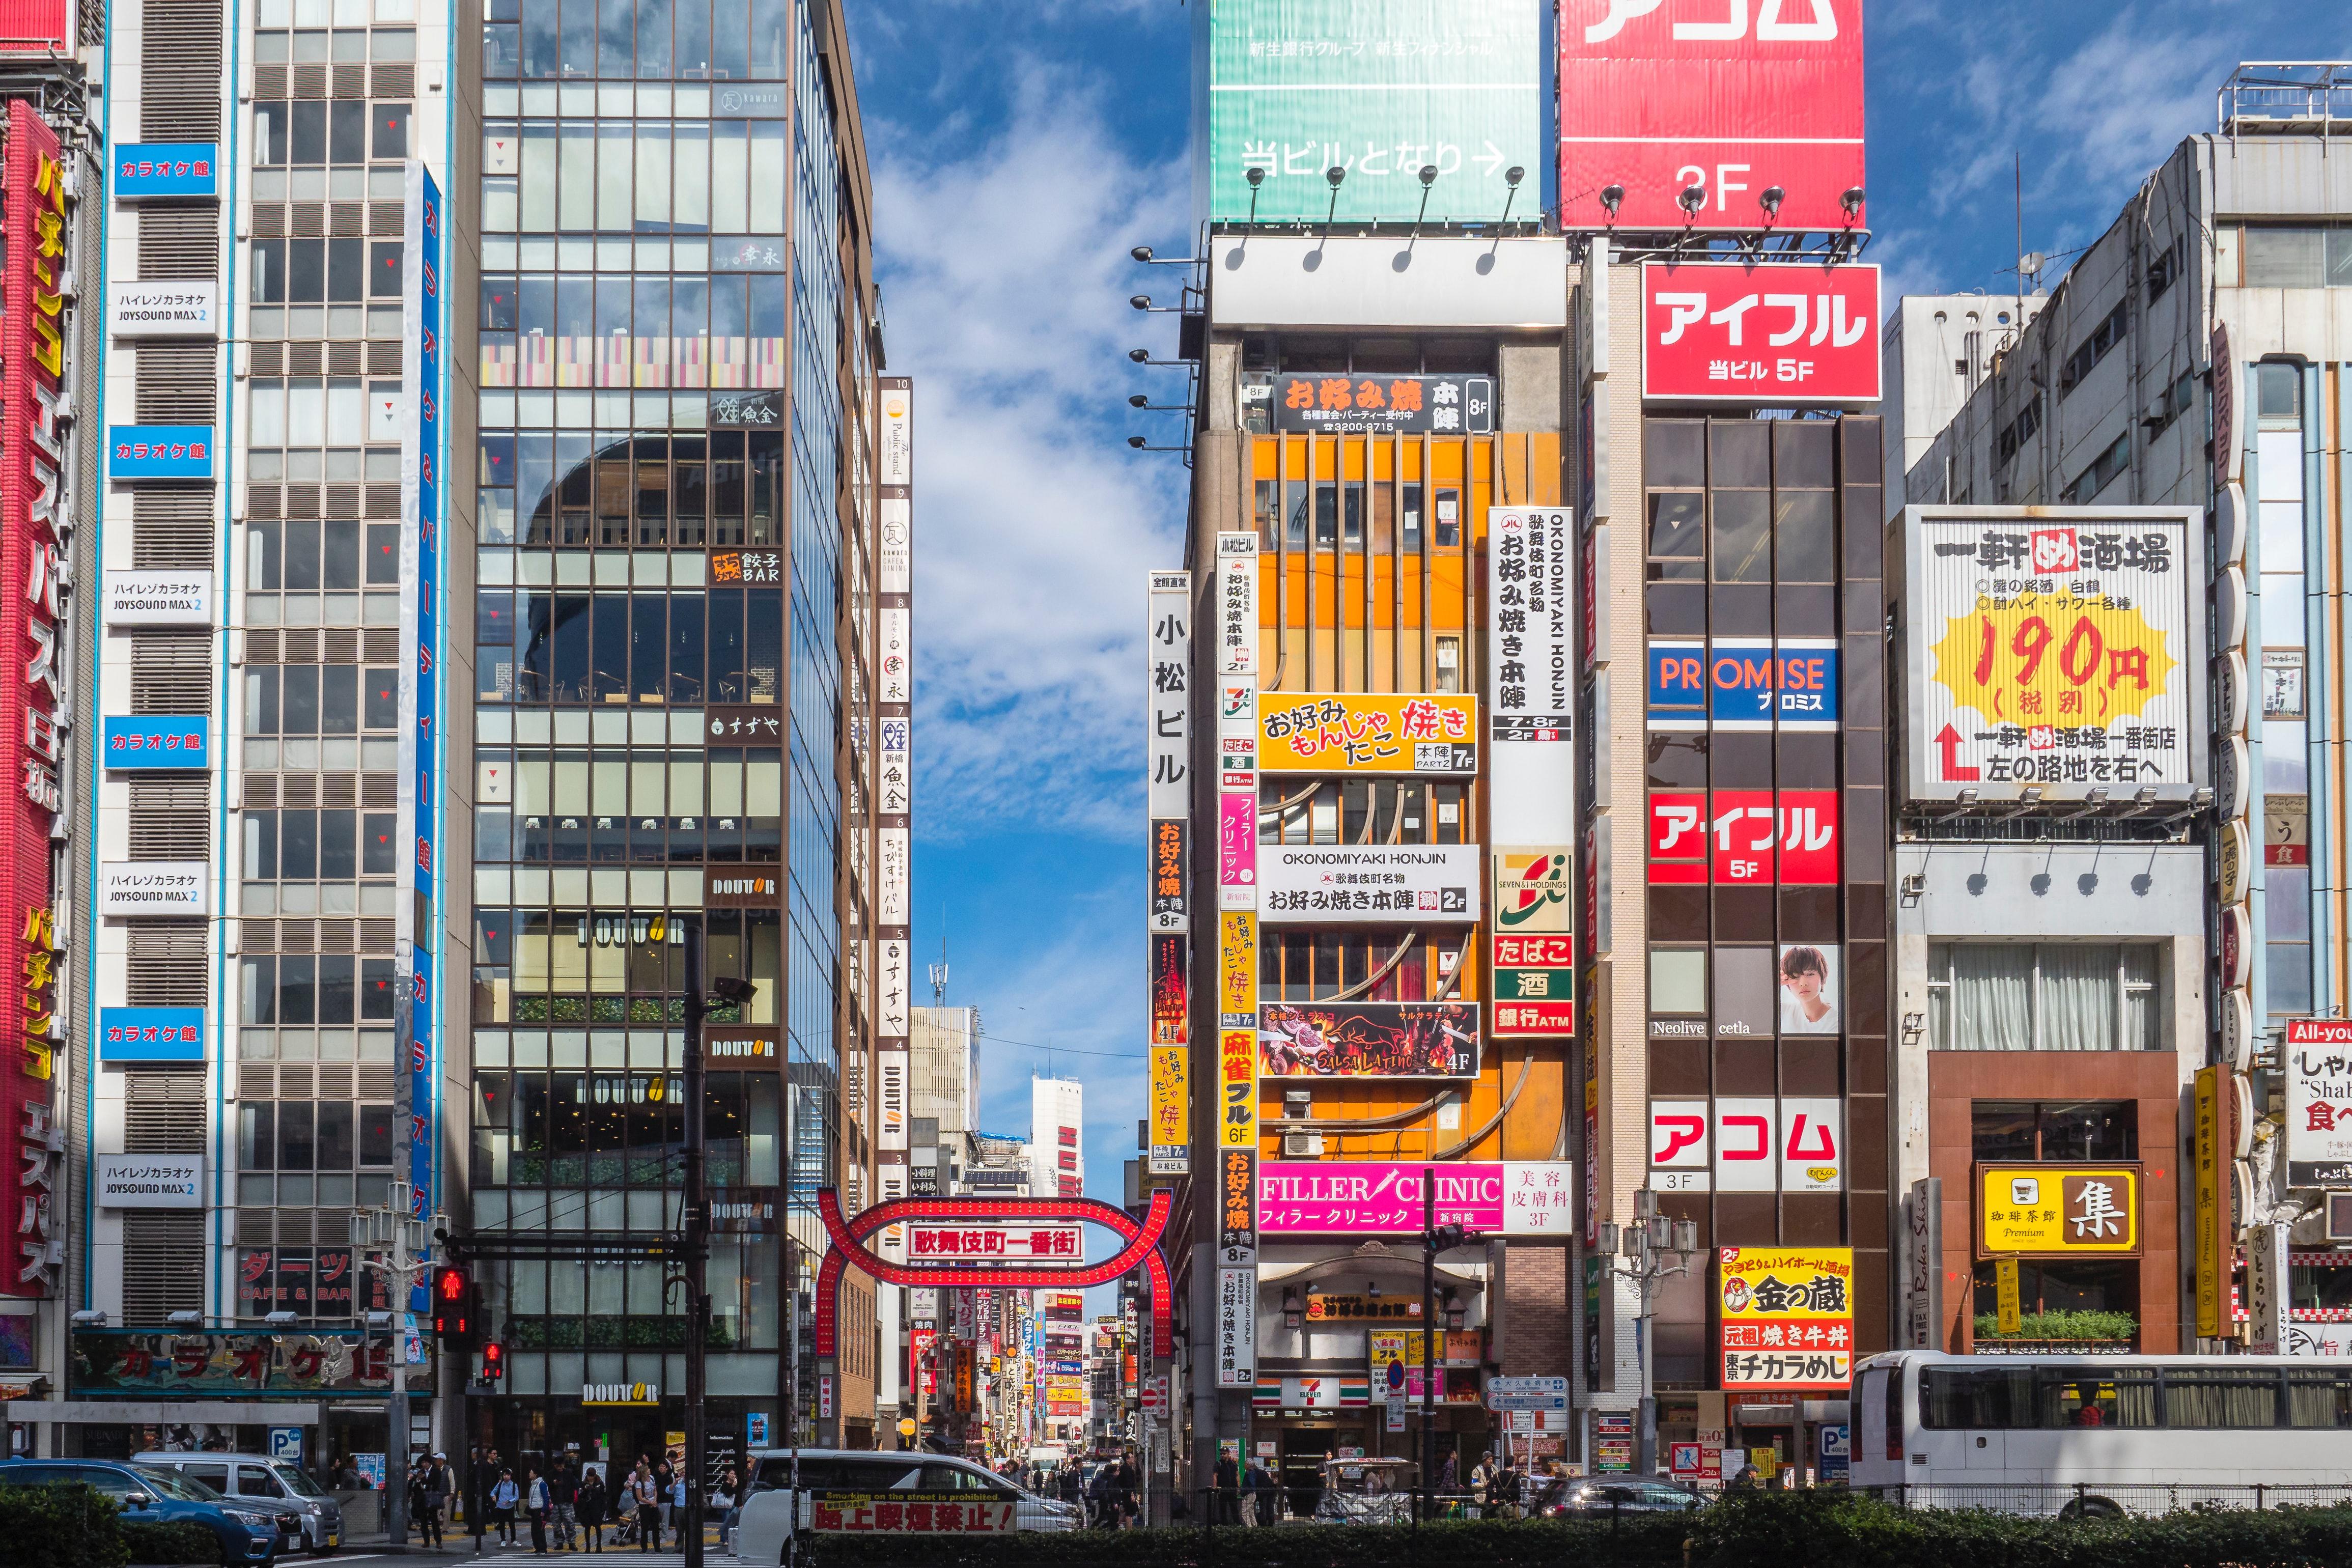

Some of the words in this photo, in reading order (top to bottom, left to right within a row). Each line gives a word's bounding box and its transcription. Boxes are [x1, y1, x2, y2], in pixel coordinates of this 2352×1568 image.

[1242, 140, 1462, 177] 当ビルとなり
[121, 160, 210, 178] カラオケ館
[1675, 164, 1750, 211] 3F
[120, 294, 206, 306] ハイレゾカラオケ
[119, 310, 171, 321] JOYSOUND
[199, 310, 207, 321] 2
[1655, 292, 1867, 347] アイフル
[1709, 360, 1768, 381] 当ビル
[1777, 359, 1814, 382] 5F
[897, 379, 908, 389] 10
[1250, 387, 1264, 397] 8F
[1285, 379, 1423, 411] お好み焼
[1433, 381, 1460, 430] 本陣
[1469, 399, 1488, 415] 8F
[741, 406, 778, 424] 魚金
[893, 423, 902, 449] Public
[1334, 423, 1393, 432] 3200-9715
[117, 443, 206, 460] カラオケ館
[893, 451, 902, 475] stand
[898, 488, 904, 498] 9
[1222, 538, 1253, 553] 小松ビル
[1934, 527, 2172, 575] 一軒め酒場
[742, 553, 780, 568] 餃子
[1528, 514, 1545, 612] 歌舞伎町名物
[743, 568, 779, 581] BAR
[1550, 514, 1564, 638] OKONOMIYAKI
[115, 583, 201, 595] ハイレゾカラオケ
[2070, 579, 2100, 594] 白鶴
[114, 599, 166, 610] JOYSOUND
[194, 599, 202, 610] 2
[898, 598, 904, 608] 8
[1498, 534, 1526, 709] お好み焼き本陣
[1973, 615, 2149, 690] 190円
[1227, 662, 1248, 671] 2F
[1660, 658, 1825, 689] PROMISE
[1551, 645, 1565, 710] HONJIN
[1154, 614, 1186, 785] 小松ビル
[1757, 691, 1824, 711] プロミス
[898, 707, 904, 716] 7
[1401, 699, 1467, 738] 焼き
[729, 716, 779, 736] すずや
[1507, 730, 1533, 740] 2F
[112, 734, 201, 751] カラオケ館
[1223, 739, 1253, 752] たばこ
[1974, 723, 2176, 751] 一軒め酒場一番街店
[1417, 745, 1450, 759] 本陣
[1453, 749, 1474, 768] 7F
[1231, 757, 1245, 769] 酒
[1986, 754, 2163, 782] 左の路地を右へ
[883, 766, 906, 809] 魚金
[898, 817, 904, 827] 6
[1240, 798, 1252, 852] フィラー
[1656, 806, 1833, 851] アイフル
[1223, 815, 1237, 883] クリニック
[2276, 845, 2293, 864] 食
[1158, 822, 1181, 896] お好み焼
[1282, 853, 1386, 864] OKONOMIYAKI
[1390, 853, 1446, 864] HONJIN
[885, 839, 899, 915] ちびすけバル
[1730, 859, 1758, 878] 5F
[110, 875, 198, 887] ハイレゾカラオケ
[713, 878, 774, 895] DOUTOR
[1335, 873, 1405, 884] 歌舞伎町名物
[110, 891, 163, 902] JOYSOUND
[190, 890, 198, 903] 2
[1269, 889, 1415, 911] お好み焼き本陣
[1443, 891, 1466, 909] 2F
[1160, 914, 1180, 927] 8F
[897, 929, 904, 939] 5
[1498, 939, 1568, 963] たばこ
[1228, 971, 1249, 1010] 焼き
[1517, 972, 1549, 996] 酒
[885, 962, 903, 1034] すずや
[1498, 1008, 1569, 1027] 銀行ATM
[108, 1026, 197, 1043] カラオケ館
[1159, 1025, 1179, 1040] 4F
[1653, 1021, 1704, 1034] Neolive
[1719, 1021, 1751, 1034] cetla
[712, 1039, 774, 1057] DOUTOR
[896, 1041, 903, 1050] 4
[1447, 1053, 1470, 1070] 4F
[885, 1066, 902, 1133] DOUTOR
[1160, 1104, 1180, 1141] 焼き
[1229, 1128, 1248, 1143] 6F
[1655, 1114, 1836, 1163] アコム
[897, 1155, 902, 1164] 3
[1172, 1146, 1184, 1157] 7F
[107, 1167, 194, 1179] ハイレゾカラオケ
[912, 1168, 936, 1178] 小料理
[1519, 1170, 1560, 1187] 美容
[1666, 1174, 1692, 1189] 3F
[17, 1098, 51, 1285] エスパス
[106, 1184, 159, 1194] JOYSOUND
[187, 1183, 194, 1195] 2
[1226, 1152, 1250, 1230] お好み焼
[1260, 1177, 1370, 1201] FILLER
[1511, 1191, 1569, 1208] 皮膚科
[712, 1202, 773, 1219] DOUTOR
[1260, 1209, 1320, 1224] フィラー
[1326, 1209, 1408, 1224] クリニック
[1440, 1212, 1474, 1223] 新宿院
[1991, 1210, 2056, 1222] 珈琲茶館
[2069, 1180, 2126, 1239] 集
[1529, 1213, 1550, 1227] 3F
[2003, 1227, 2045, 1237] Premium
[914, 1230, 1076, 1254] 歌舞伎町一番街
[1227, 1248, 1248, 1263] 8F
[1722, 1248, 1739, 1264] 2F
[242, 1251, 349, 1282] ダーツ
[240, 1287, 288, 1300] CAFE
[318, 1287, 351, 1300] BAR
[1753, 1274, 1846, 1313] 金の蔵
[914, 1320, 933, 1329] 焼肉
[1725, 1327, 1759, 1345] 元祖
[1762, 1325, 1849, 1348] 焼き牛丼
[1726, 1353, 1740, 1380] 東京
[1740, 1353, 1849, 1380] チカラめし
[1239, 1371, 1250, 1381] 2F
[583, 1382, 657, 1402] DOUTOR
[274, 1434, 289, 1456] P
[1824, 1431, 1839, 1453] P
